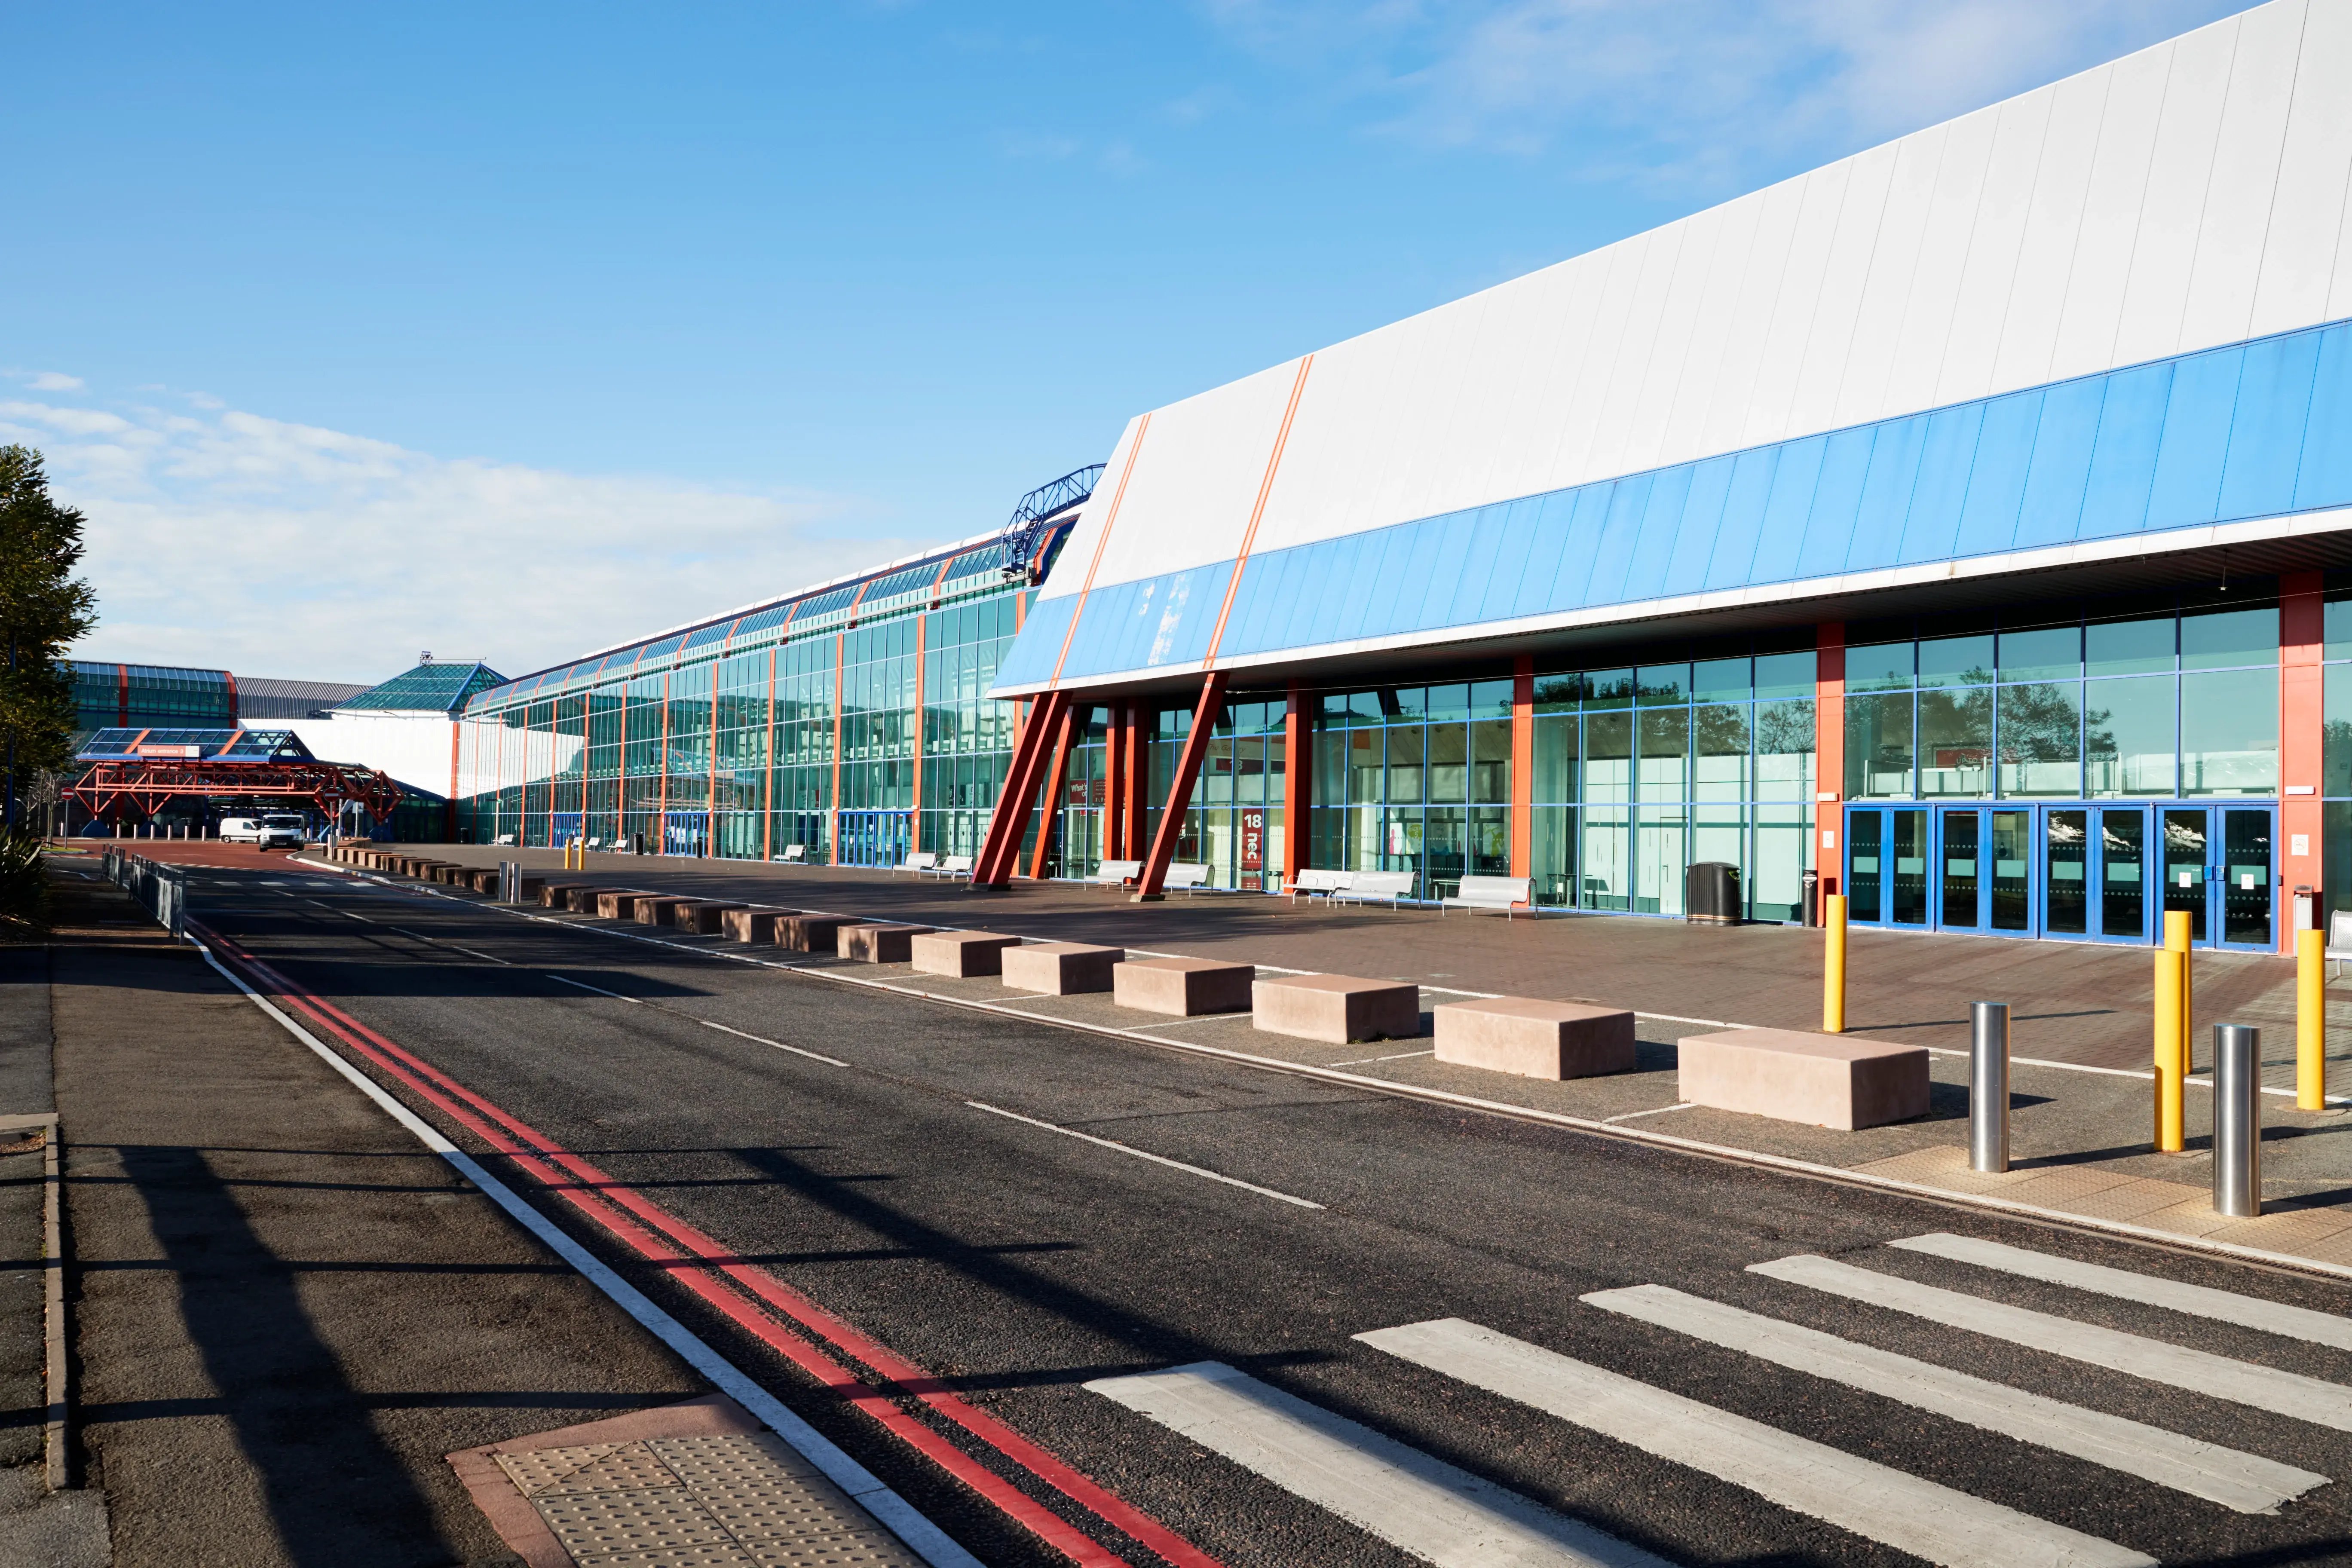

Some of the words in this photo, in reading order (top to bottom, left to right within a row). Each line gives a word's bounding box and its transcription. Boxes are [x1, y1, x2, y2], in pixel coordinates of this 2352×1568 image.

[1221, 745, 1246, 753] Gary
[1071, 783, 1087, 792] What's
[1244, 814, 1262, 828] 18
[1247, 833, 1257, 860] nec
